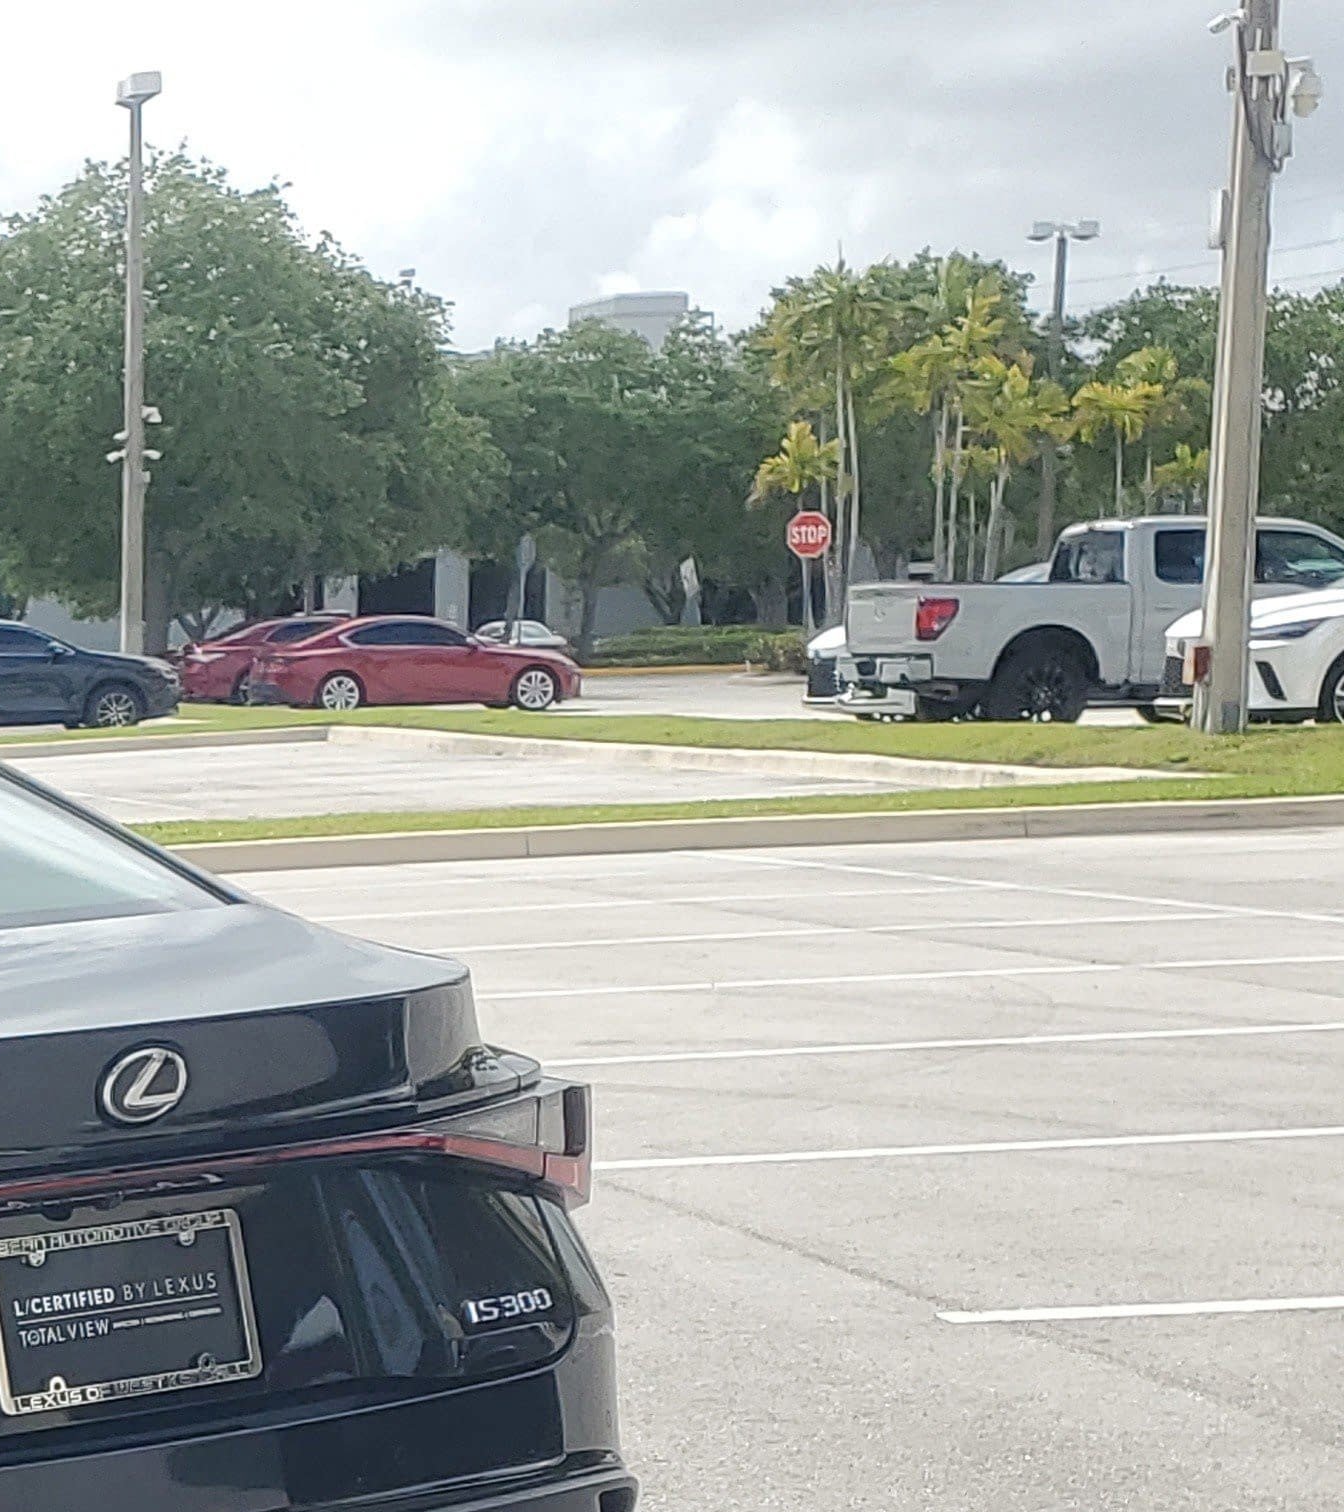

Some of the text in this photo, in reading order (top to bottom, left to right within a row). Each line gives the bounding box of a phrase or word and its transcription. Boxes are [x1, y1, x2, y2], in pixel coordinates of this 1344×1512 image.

[791, 524, 827, 544] STOP
[49, 1222, 160, 1250] AUTOMOTIVE
[13, 1272, 217, 1317] L/CERTIFIED BY LEXUS
[18, 1324, 67, 1348] TOTAL
[66, 1317, 110, 1341] VIEW
[16, 1389, 82, 1413] LEXUS
[85, 1385, 112, 1402] OF
